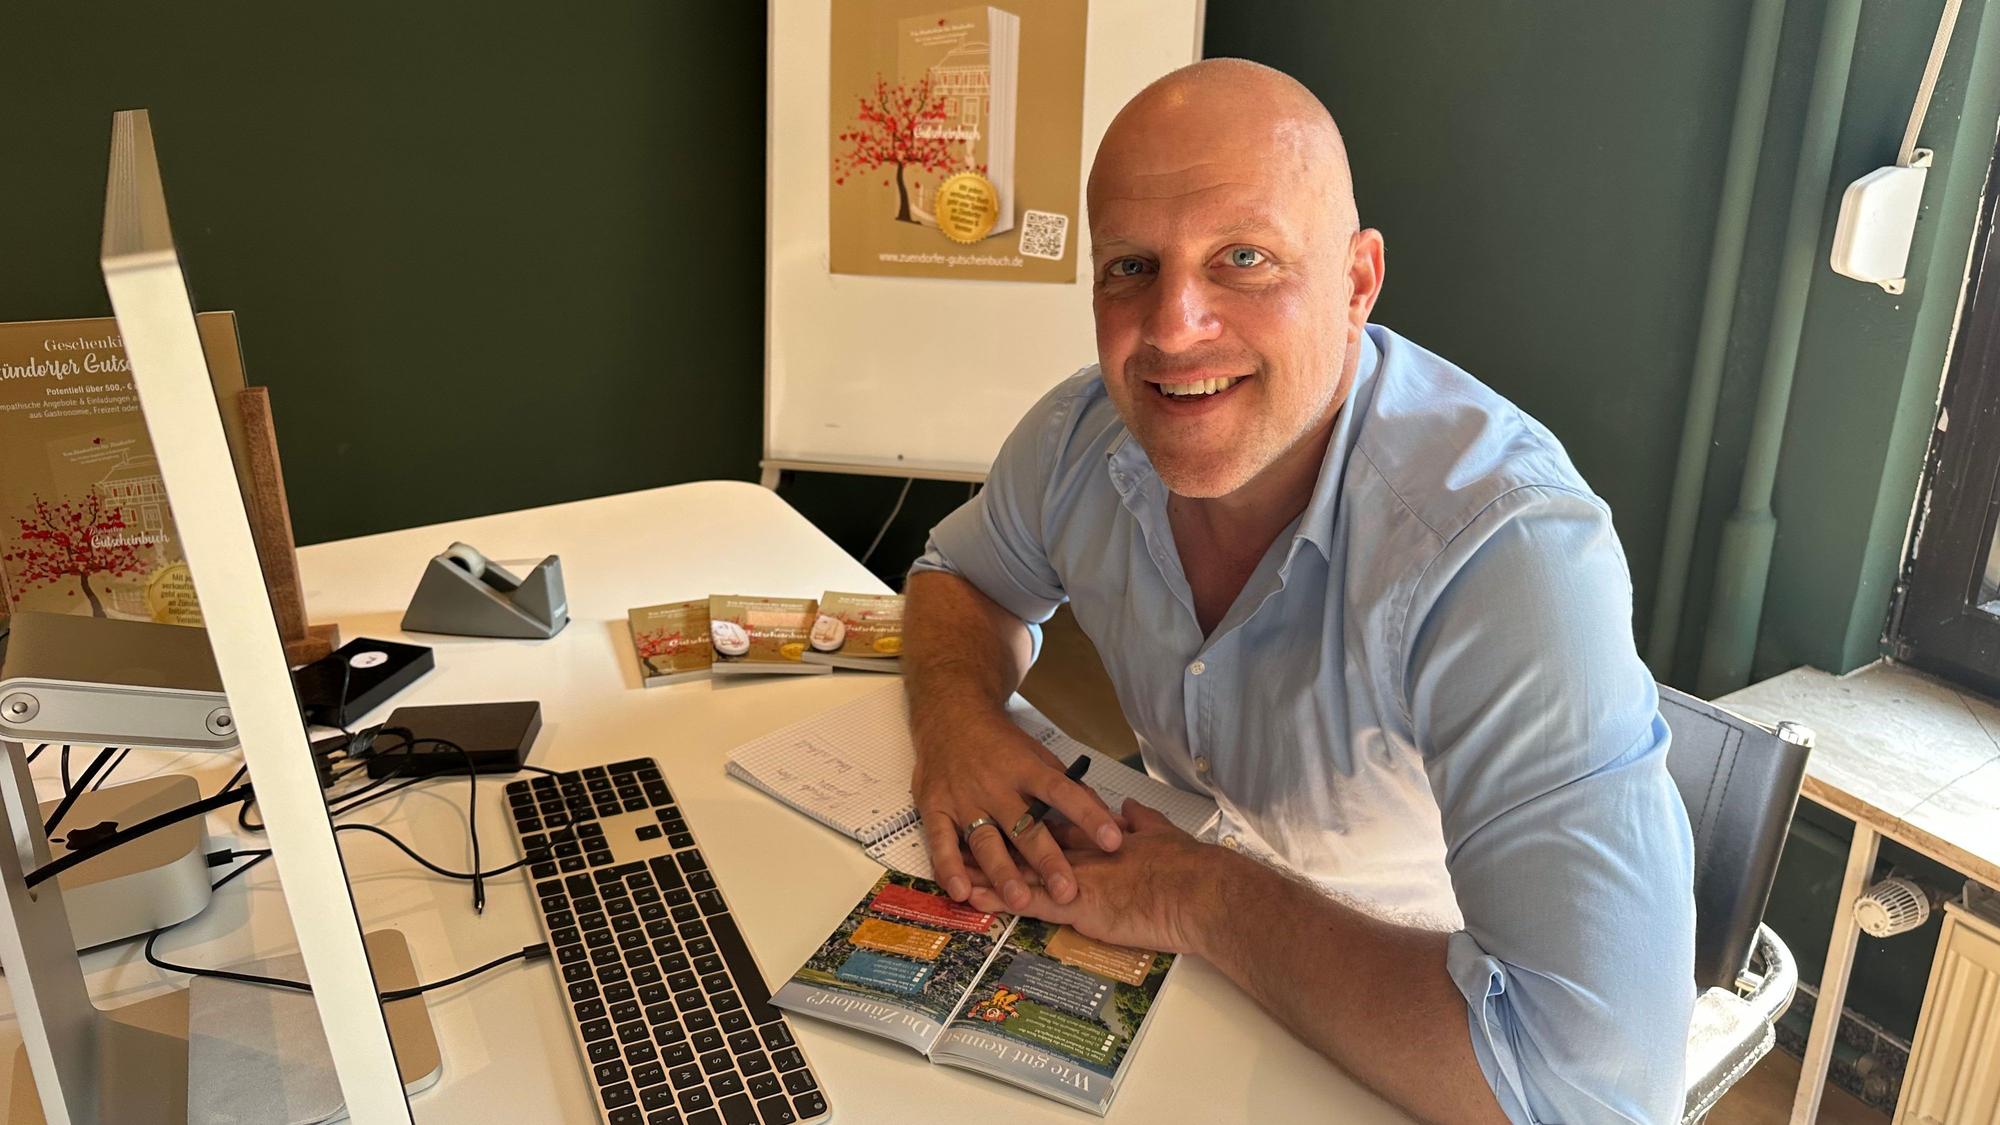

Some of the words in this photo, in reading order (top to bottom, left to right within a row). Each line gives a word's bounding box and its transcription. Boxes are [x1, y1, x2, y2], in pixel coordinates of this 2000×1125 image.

[879, 252, 1024, 268] www.zuendorfer-gutscheinbuch.de
[46, 386, 84, 396] Potentiell
[85, 384, 103, 394] über
[126, 382, 133, 390] €
[43, 398, 78, 409] Angebote
[87, 396, 131, 406] Einladungen
[91, 531, 170, 549] Gutscheinbuch
[801, 991, 899, 1024] Zündorf?
[901, 1014, 932, 1037] Du
[1011, 1049, 1050, 1069] gut
[649, 1068, 659, 1076] 3
[681, 1072, 691, 1080] W
[1051, 1063, 1090, 1092] Wie
[690, 1094, 700, 1102] Q
